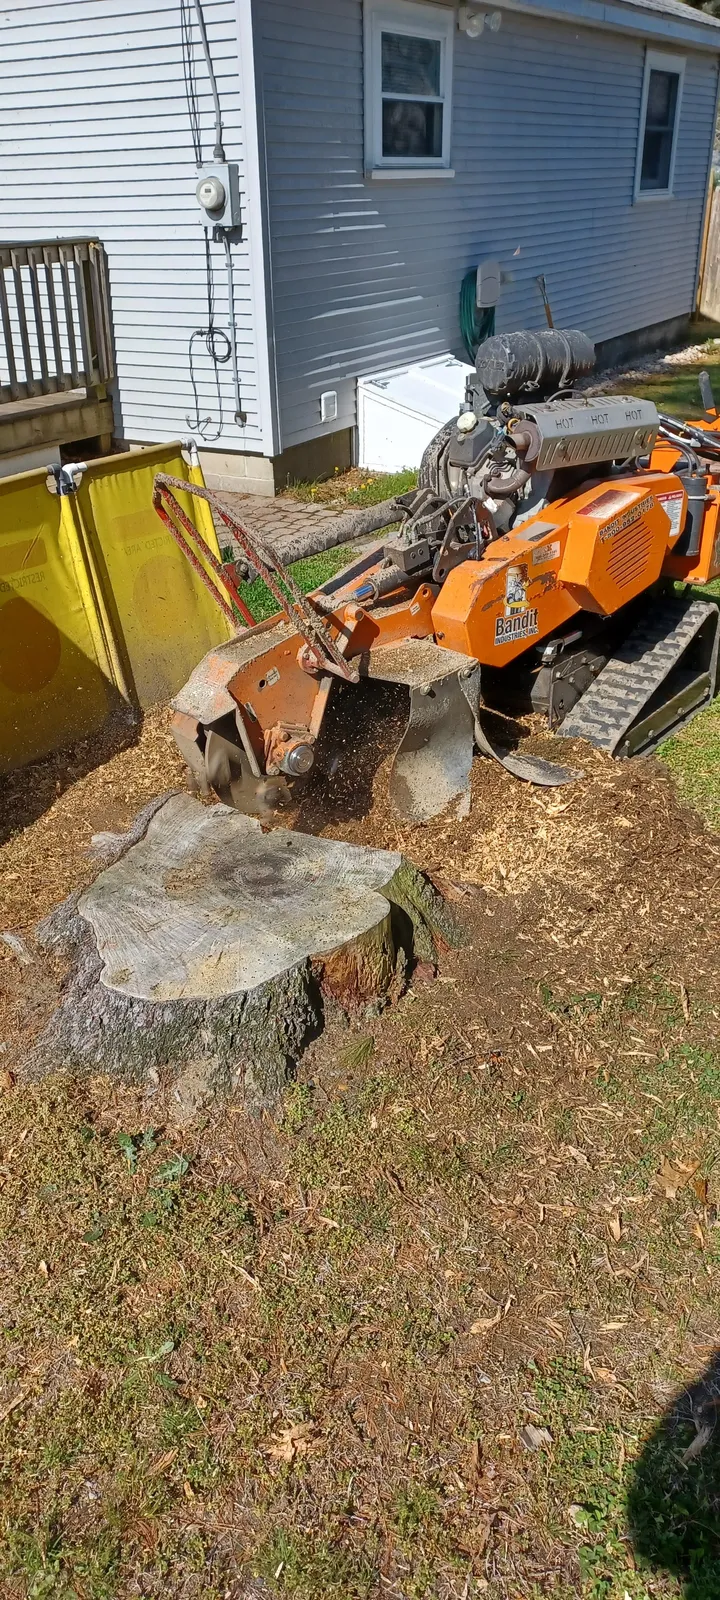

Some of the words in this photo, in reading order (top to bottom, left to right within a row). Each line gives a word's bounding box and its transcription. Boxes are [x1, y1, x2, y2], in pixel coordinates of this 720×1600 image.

[555, 417, 574, 429] HOT
[590, 413, 609, 425] HOT
[624, 409, 642, 421] HOT
[599, 518, 620, 536] BANDIT
[496, 608, 538, 637] Bandit
